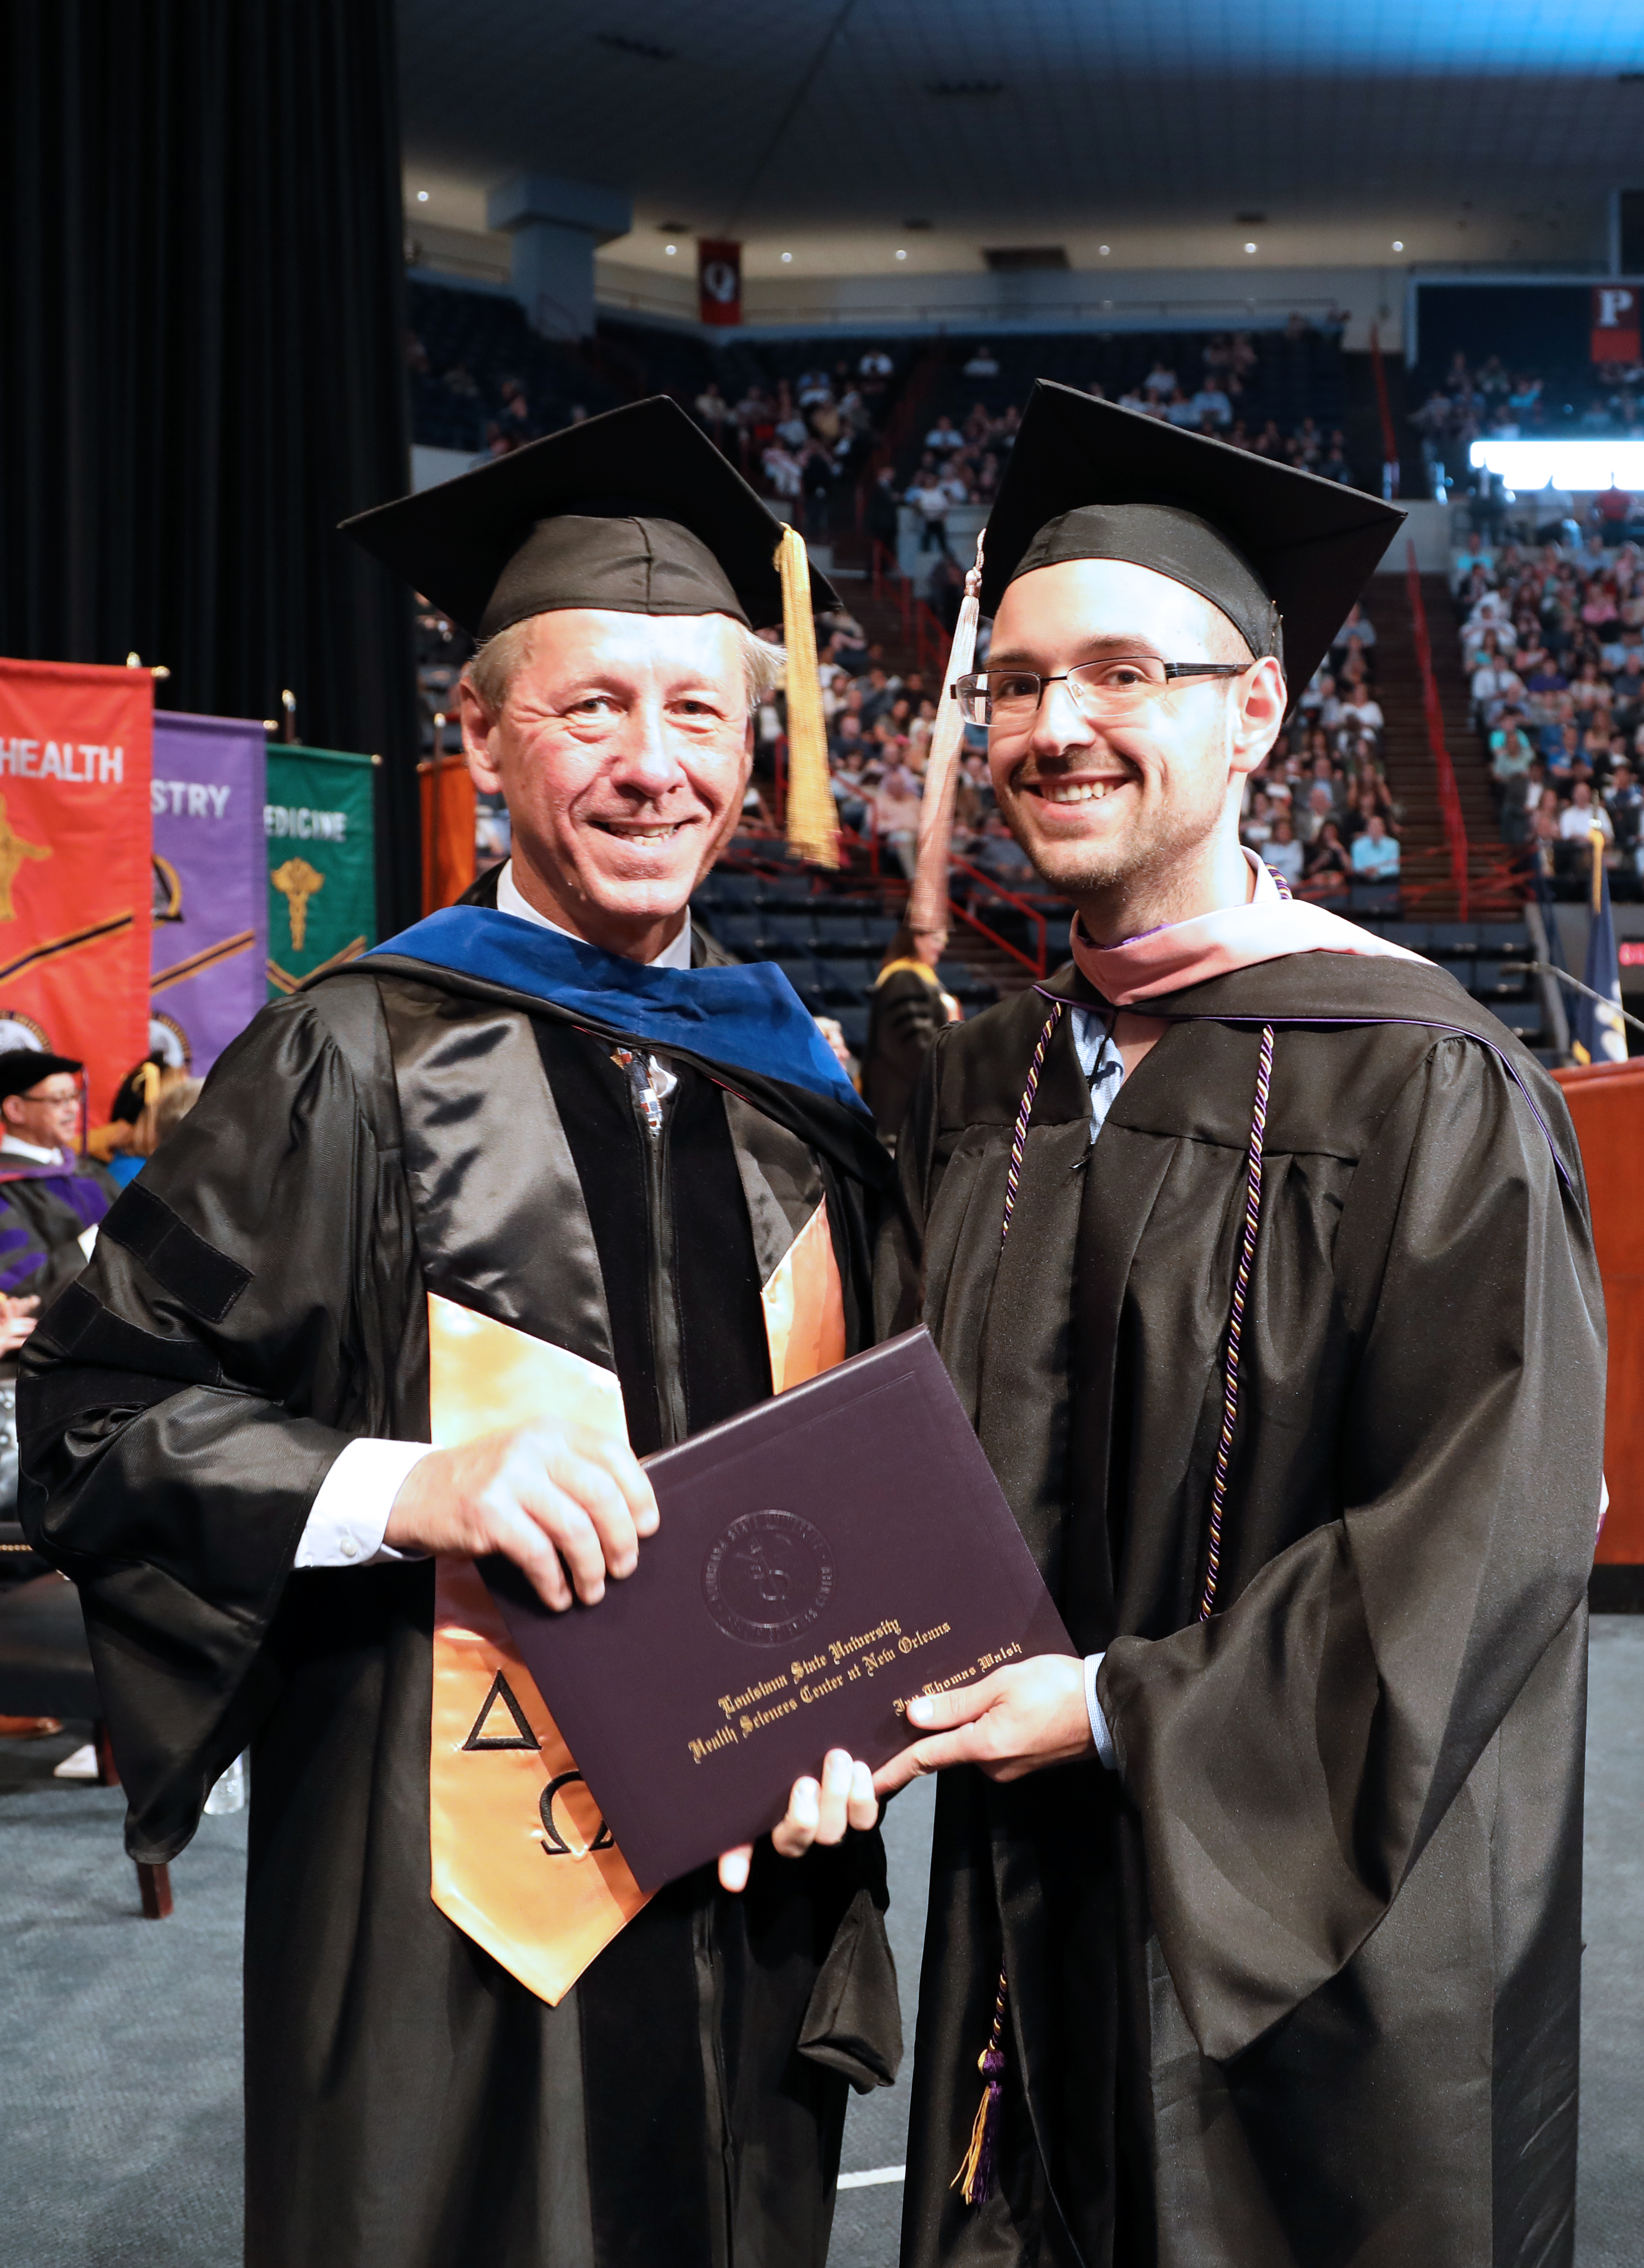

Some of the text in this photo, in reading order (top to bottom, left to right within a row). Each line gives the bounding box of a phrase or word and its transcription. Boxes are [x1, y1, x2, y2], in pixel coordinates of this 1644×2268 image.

[1599, 289, 1634, 327] P
[0, 737, 124, 784] HEALTH
[687, 1622, 952, 1764] Health Sciences Center at New Orleans
[718, 1619, 902, 1720] Louisiana State University
[922, 1641, 1022, 1696] Thomas Walsh
